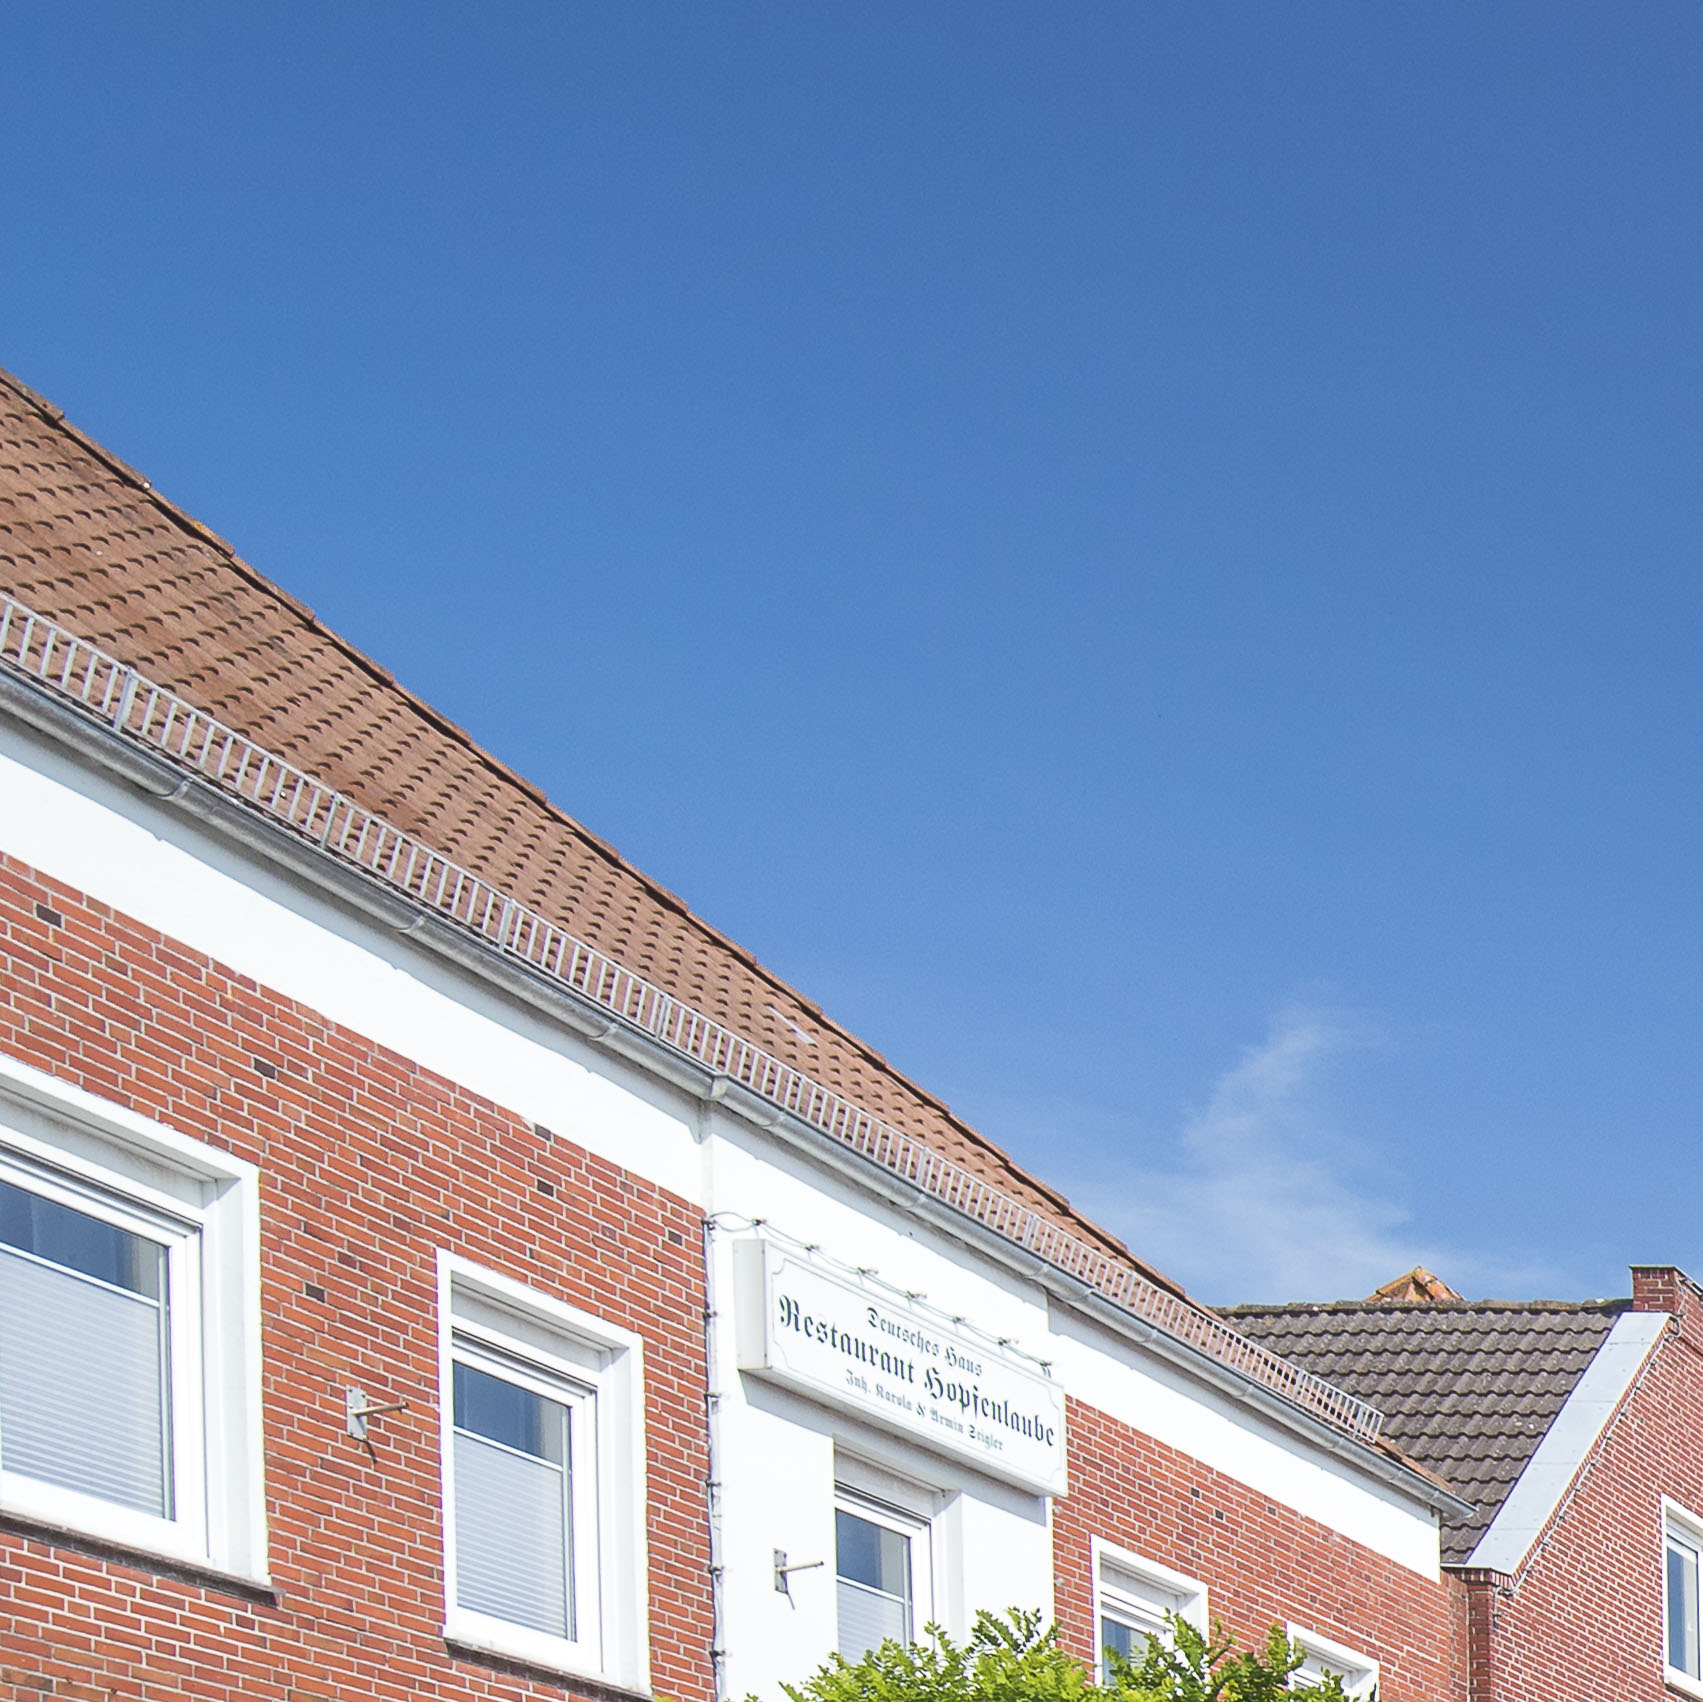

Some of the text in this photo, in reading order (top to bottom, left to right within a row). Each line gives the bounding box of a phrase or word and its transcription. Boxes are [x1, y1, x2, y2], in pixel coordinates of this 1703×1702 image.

[779, 1295, 1055, 1447] Restaurant Hopfenlaube
[867, 1307, 983, 1376] Deutsches Haus
